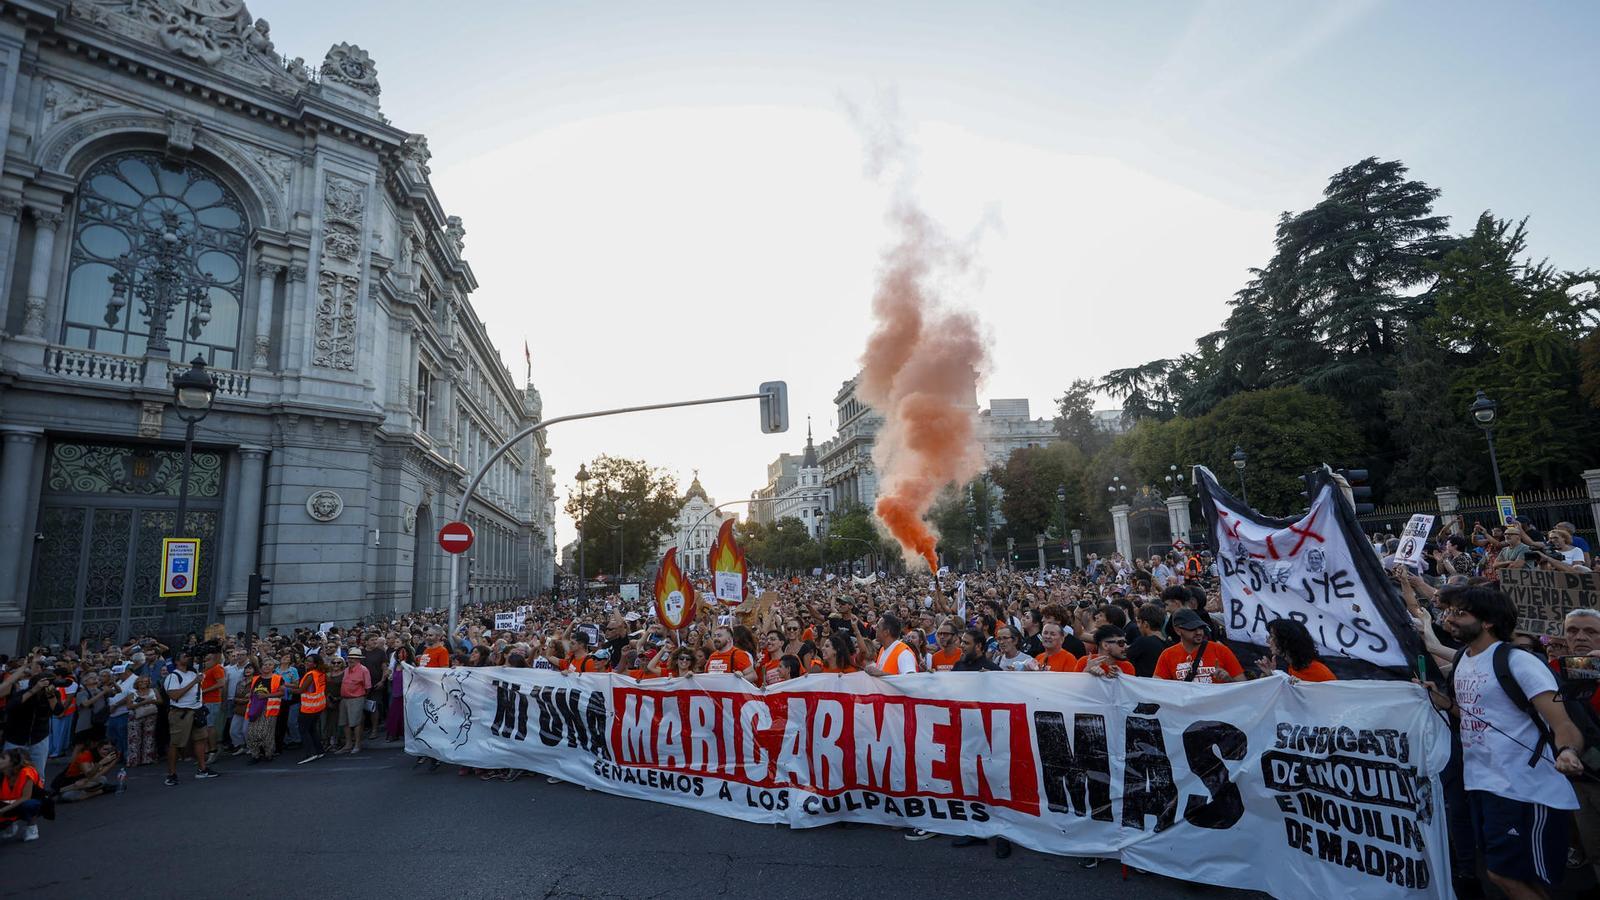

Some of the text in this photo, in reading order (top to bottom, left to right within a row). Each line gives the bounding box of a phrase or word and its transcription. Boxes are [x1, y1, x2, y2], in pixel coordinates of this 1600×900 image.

[1222, 556, 1355, 604] DESUYE
[1502, 569, 1597, 591] EL PLAN DE
[1502, 585, 1597, 607] VIVIENDA NO
[1517, 605, 1572, 620] EBE SE
[490, 680, 1248, 833] NI UNA MARICARMEN MÁS
[1271, 759, 1303, 786] DE
[719, 781, 733, 801] A
[746, 787, 789, 810] LOS
[802, 791, 990, 822] CULPABLES
[1275, 795, 1298, 814] E
[1284, 817, 1430, 889] DE MADRID
